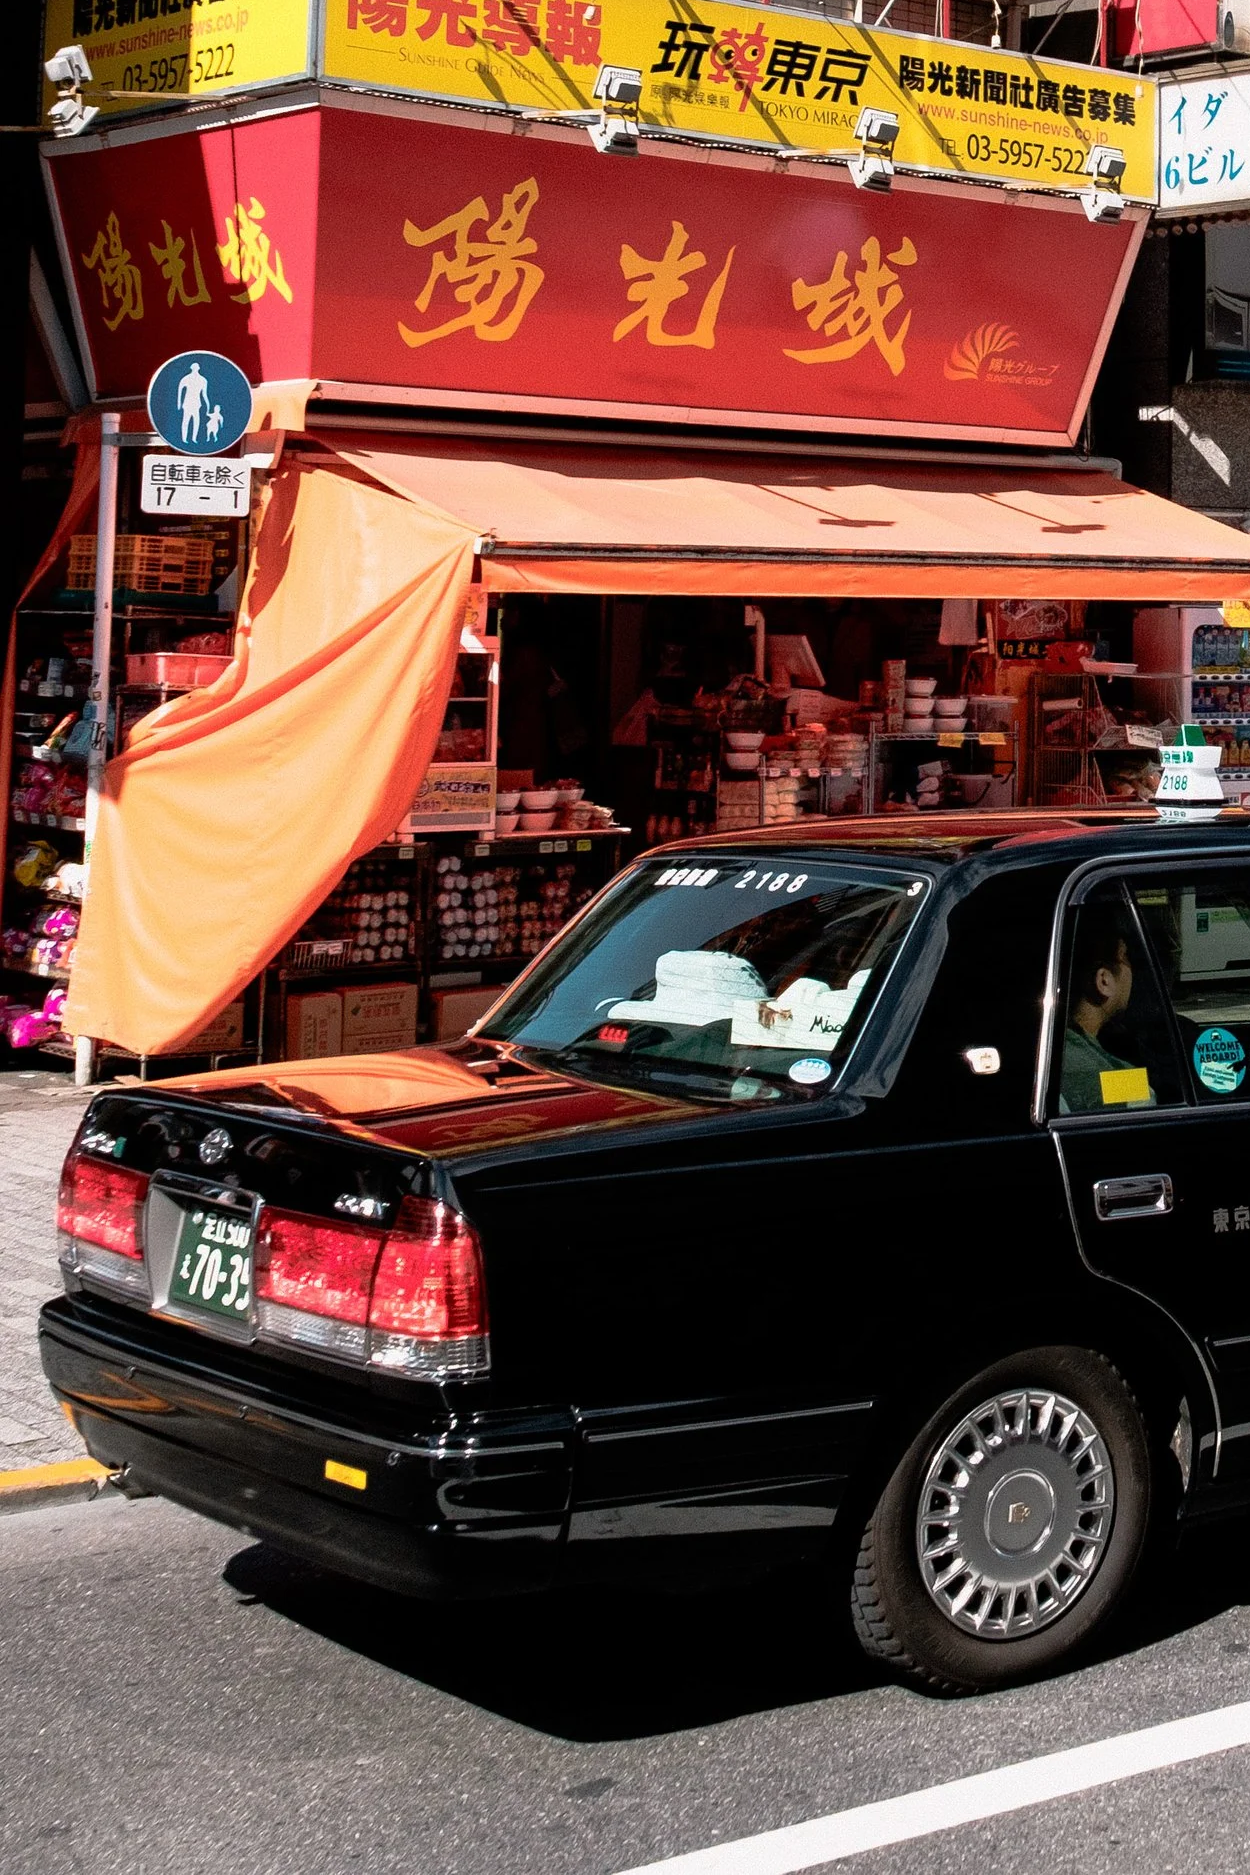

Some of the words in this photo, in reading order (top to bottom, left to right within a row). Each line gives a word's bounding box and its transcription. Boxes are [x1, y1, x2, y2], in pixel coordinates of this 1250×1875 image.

[84, 7, 249, 62] www.sunshine-news.co.jp
[122, 42, 235, 93] 03-5957-5222
[899, 54, 1136, 127] 陽光新聞社廣告募集
[758, 99, 809, 122] TOKYO
[812, 109, 860, 130] MIRAC
[917, 100, 1109, 145] www.sunshine-news.co.jp
[1168, 90, 1230, 136] イダ
[1165, 145, 1246, 191] 6ビル
[151, 462, 246, 485] 自転車を除く
[1162, 775, 1189, 791] 2188
[734, 869, 809, 894] 2188
[1196, 1040, 1241, 1053] WELCOME
[1200, 1051, 1240, 1064] ABOARD!
